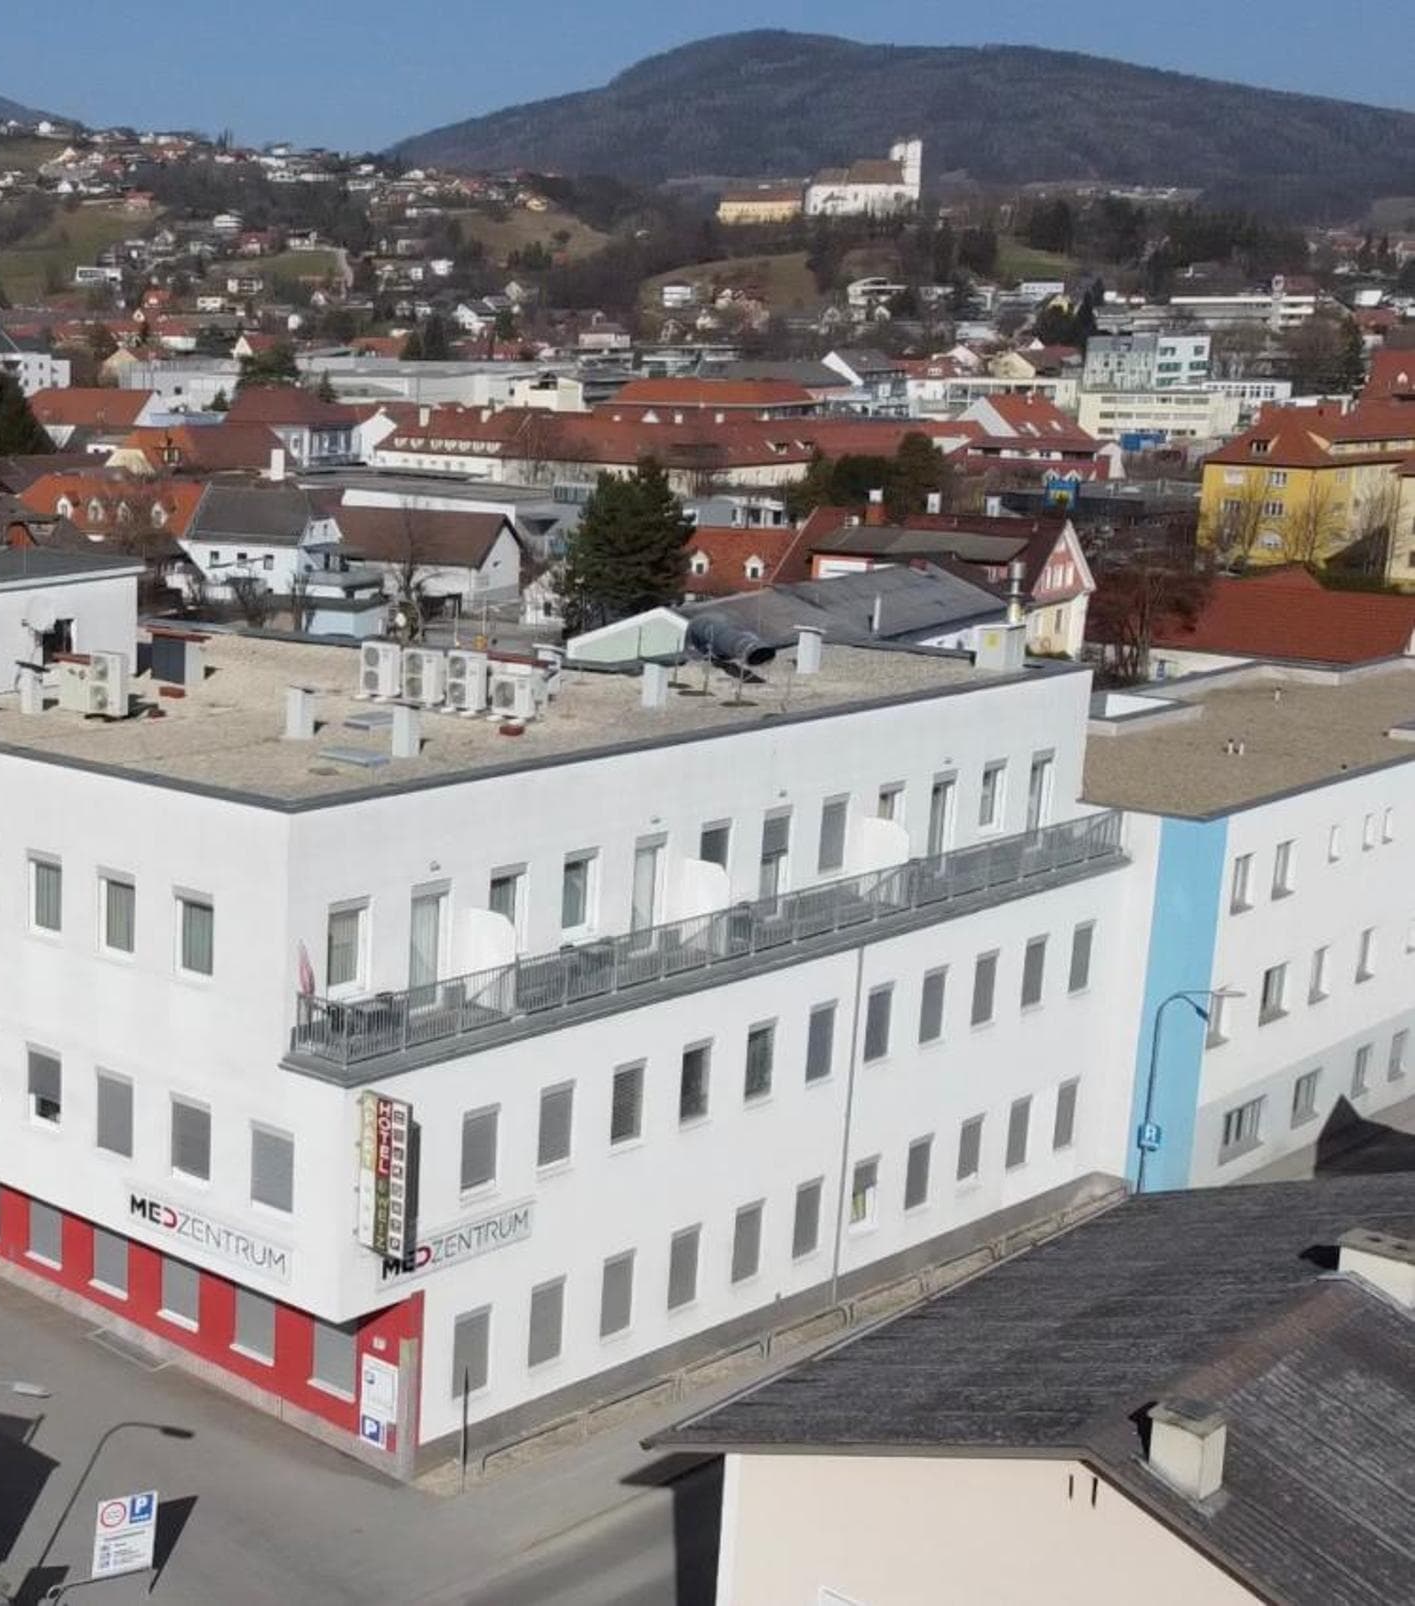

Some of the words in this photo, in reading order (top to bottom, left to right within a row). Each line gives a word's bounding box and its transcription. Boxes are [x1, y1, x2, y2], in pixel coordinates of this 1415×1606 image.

[378, 1101, 391, 1174] HOTEL
[130, 1194, 286, 1275] MEDZENTRUM
[382, 1208, 529, 1280] MEDZENTRUM
[135, 1496, 148, 1516] P
